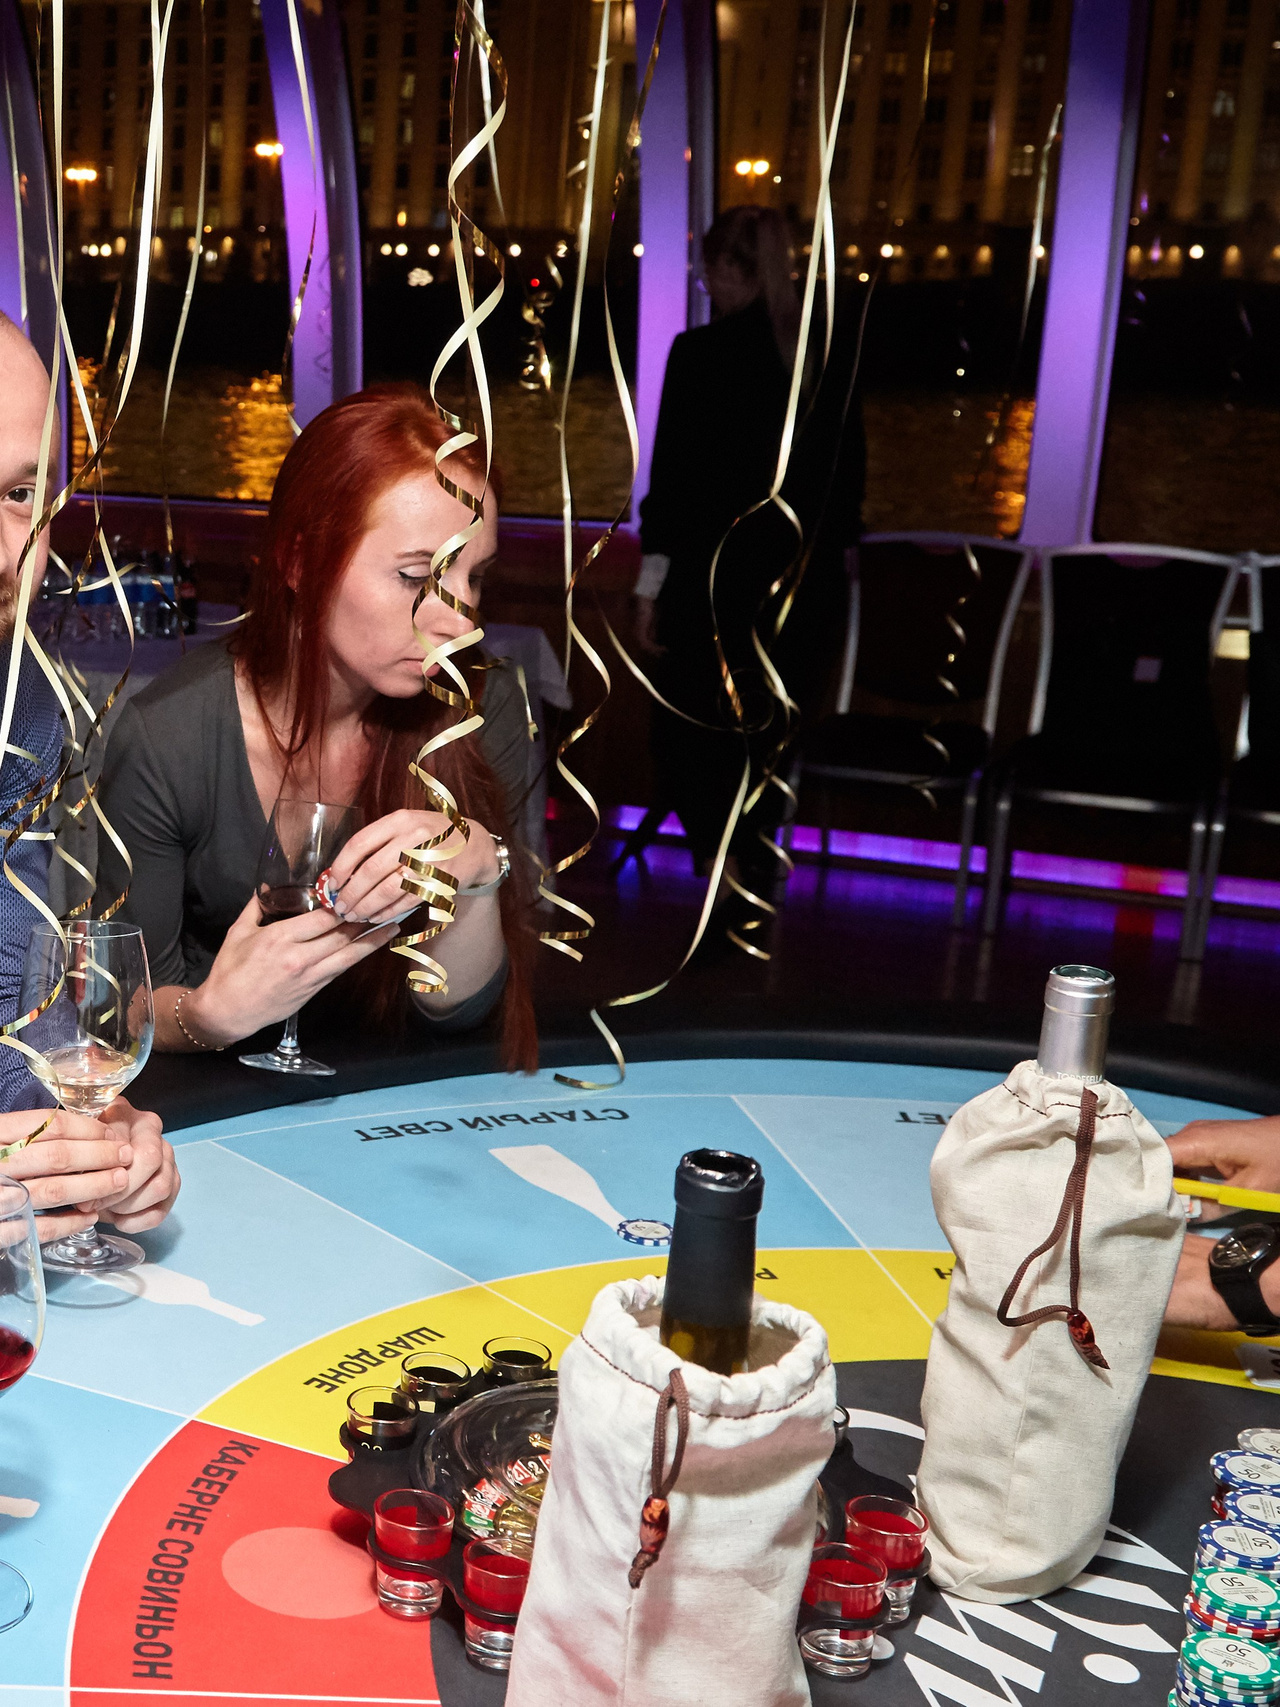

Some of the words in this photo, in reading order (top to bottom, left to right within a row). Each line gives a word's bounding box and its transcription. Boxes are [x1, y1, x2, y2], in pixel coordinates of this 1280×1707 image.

[458, 1108, 630, 1131] СТАРЫЙ
[895, 1111, 952, 1125] ЕТ
[354, 1120, 453, 1142] СВЕТ
[303, 1326, 446, 1393] ШАРДОНЕ
[1238, 1468, 1261, 1480] 50
[165, 1439, 261, 1536] КАБЕРНЕ
[1252, 1537, 1272, 1550] 50
[1220, 1577, 1245, 1587] 50
[132, 1538, 195, 1680] СОВИНЬОН
[1225, 1643, 1251, 1658] 50
